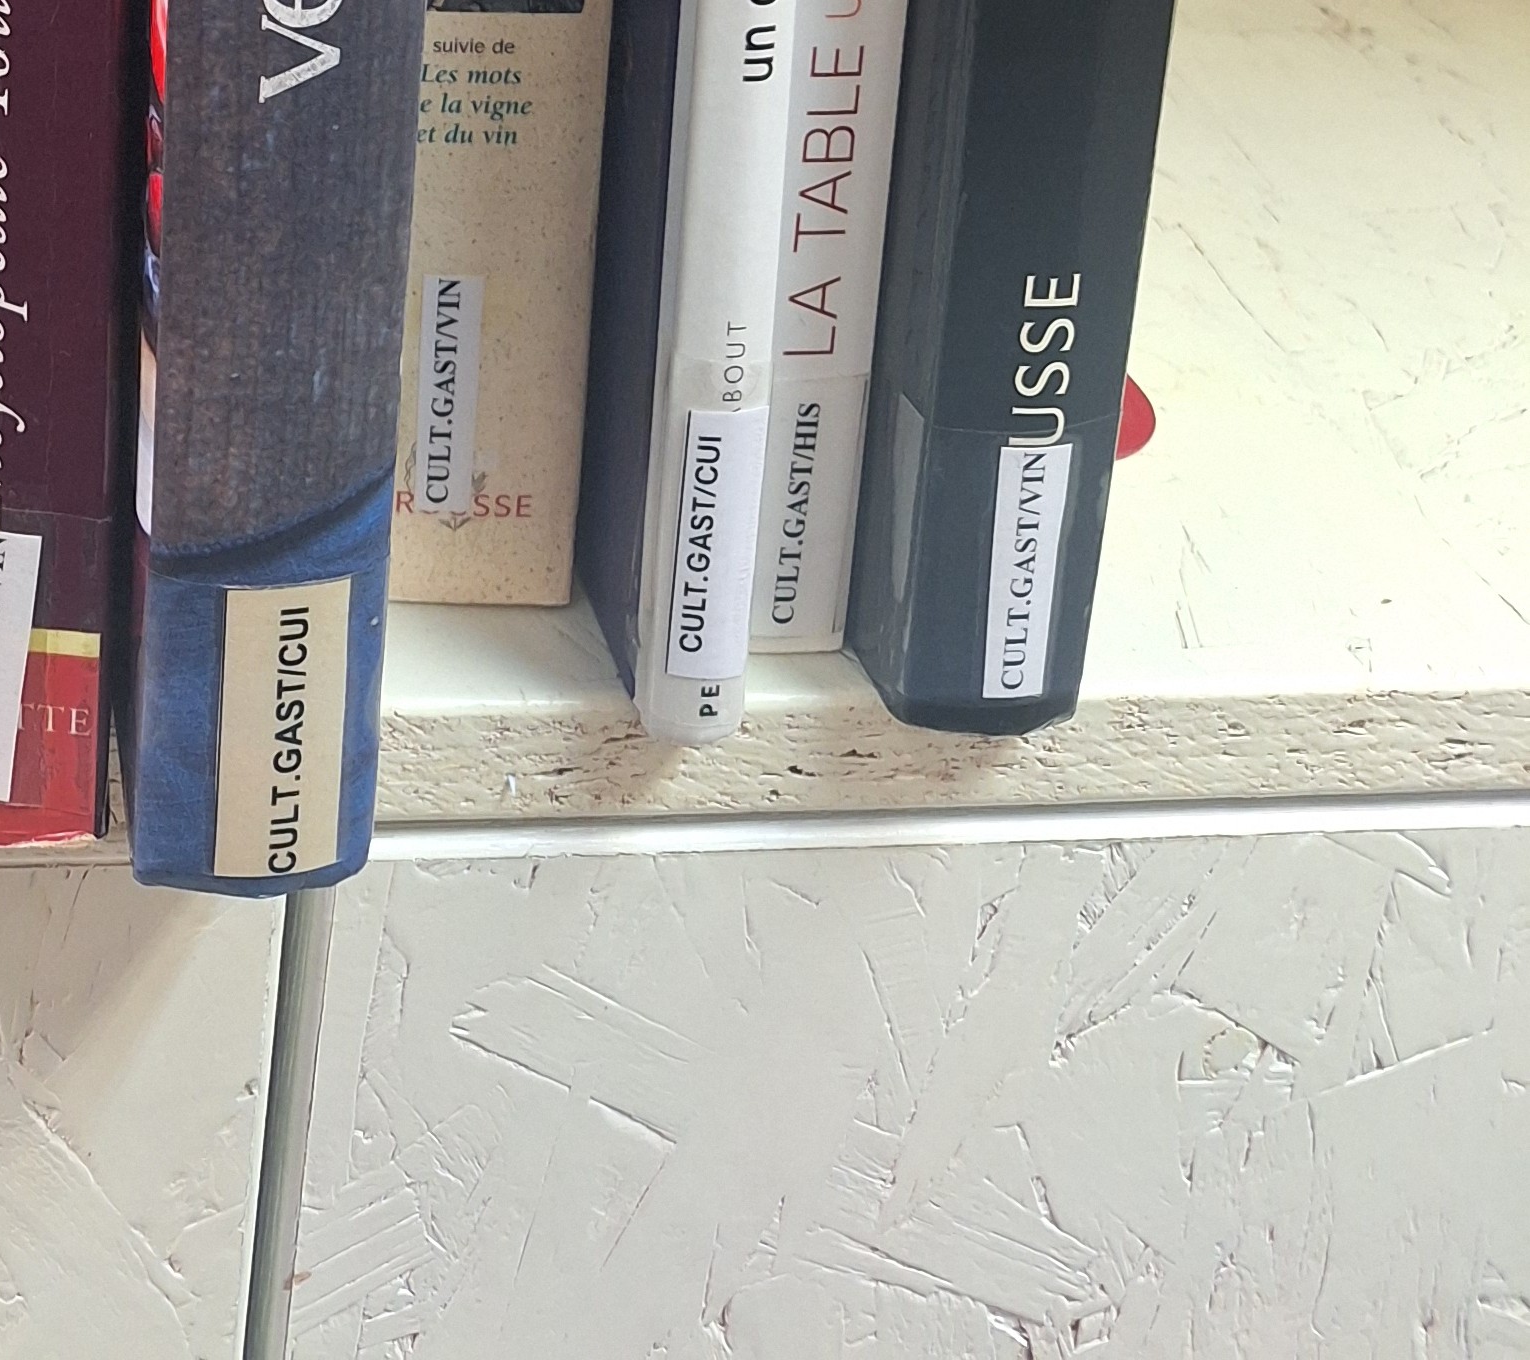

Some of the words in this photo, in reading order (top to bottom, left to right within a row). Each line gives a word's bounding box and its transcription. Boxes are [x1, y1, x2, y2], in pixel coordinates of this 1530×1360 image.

[421, 63, 458, 83] Les
[467, 68, 522, 84] mots
[433, 38, 485, 54] suivie
[492, 39, 515, 54] de
[441, 92, 462, 113] la
[471, 95, 533, 121] vigne
[742, 26, 777, 83] un
[417, 126, 436, 143] et
[444, 123, 473, 143] du
[483, 125, 518, 144] vin
[793, 44, 865, 253] TABLE
[722, 321, 747, 404] BOUT
[783, 277, 841, 356] LA
[1008, 272, 1081, 448] USSE
[424, 278, 461, 504] CULT.GAST/VIN
[679, 435, 723, 653] CULT.GAST/CUI
[771, 402, 821, 625] CULT.GAST/HIS
[1001, 452, 1048, 691] CULT.GAST/VIN
[268, 606, 310, 875] CULT.GAST/CUI
